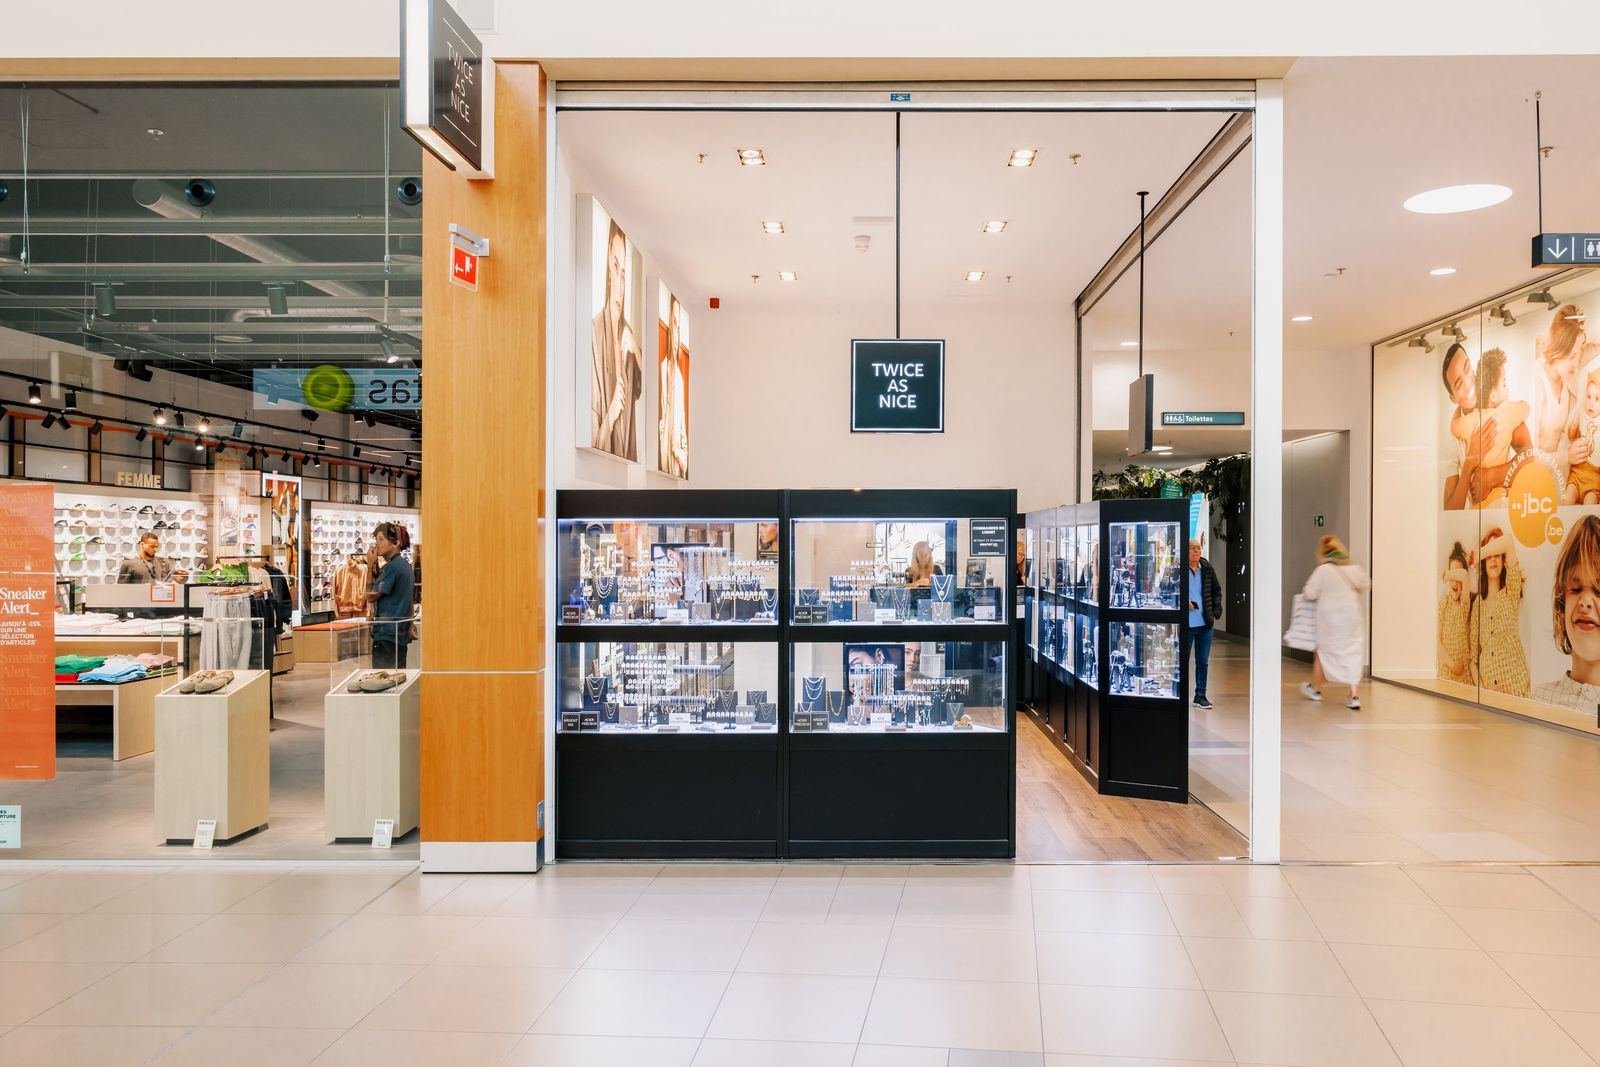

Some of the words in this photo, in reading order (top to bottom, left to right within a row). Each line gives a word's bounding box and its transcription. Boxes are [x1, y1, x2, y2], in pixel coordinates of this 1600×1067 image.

[446, 41, 474, 85] TWICE
[454, 74, 466, 97] AS
[450, 90, 470, 123] NICE
[871, 363, 924, 377] TWICE
[887, 379, 908, 392] AS
[879, 394, 917, 408] NICE
[117, 471, 161, 488] FEMME
[1521, 493, 1552, 518] jbc
[0, 587, 47, 600] Sneaker
